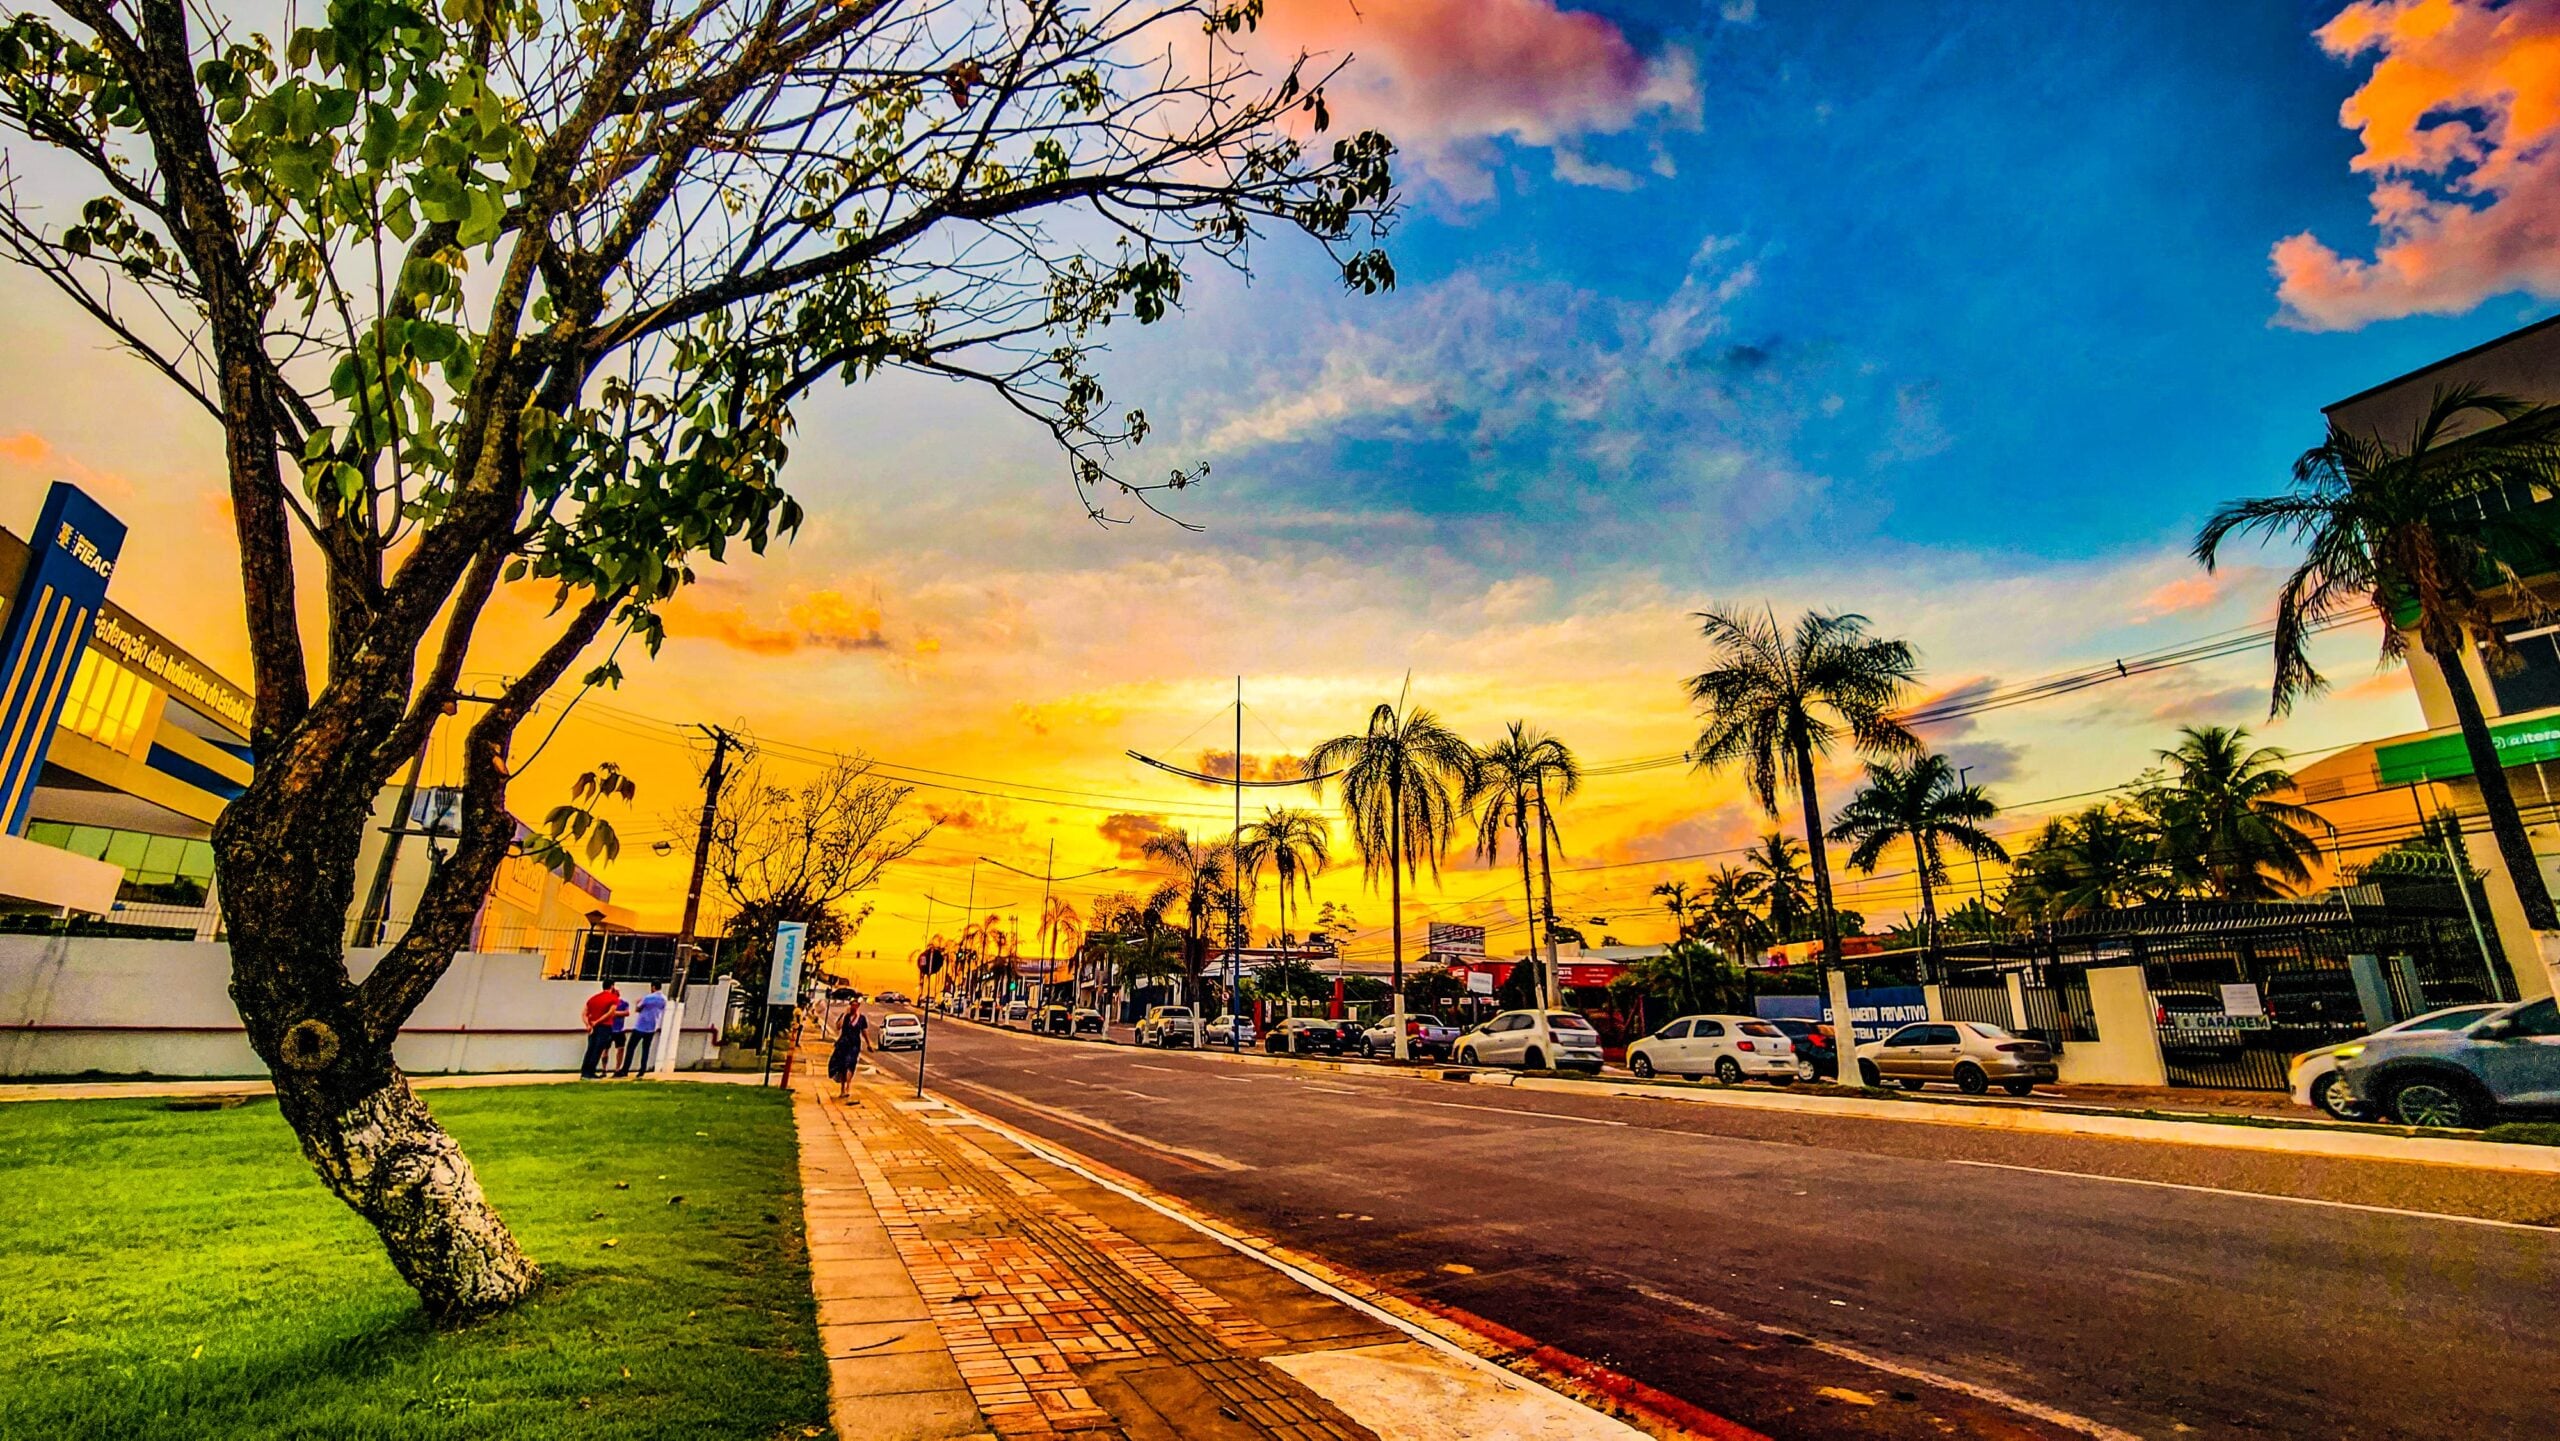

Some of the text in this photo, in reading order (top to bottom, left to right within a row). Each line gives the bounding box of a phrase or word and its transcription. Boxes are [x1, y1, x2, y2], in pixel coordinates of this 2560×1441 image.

[72, 541, 111, 577] FIEAC
[144, 645, 167, 676] das
[162, 654, 210, 702] Indústrias
[204, 682, 220, 708] do
[215, 688, 246, 724] Estado
[781, 935, 795, 988] ENTRADA
[1880, 1005, 1927, 1021] PRIVATIVO
[2197, 1016, 2268, 1028] GARAGEM
